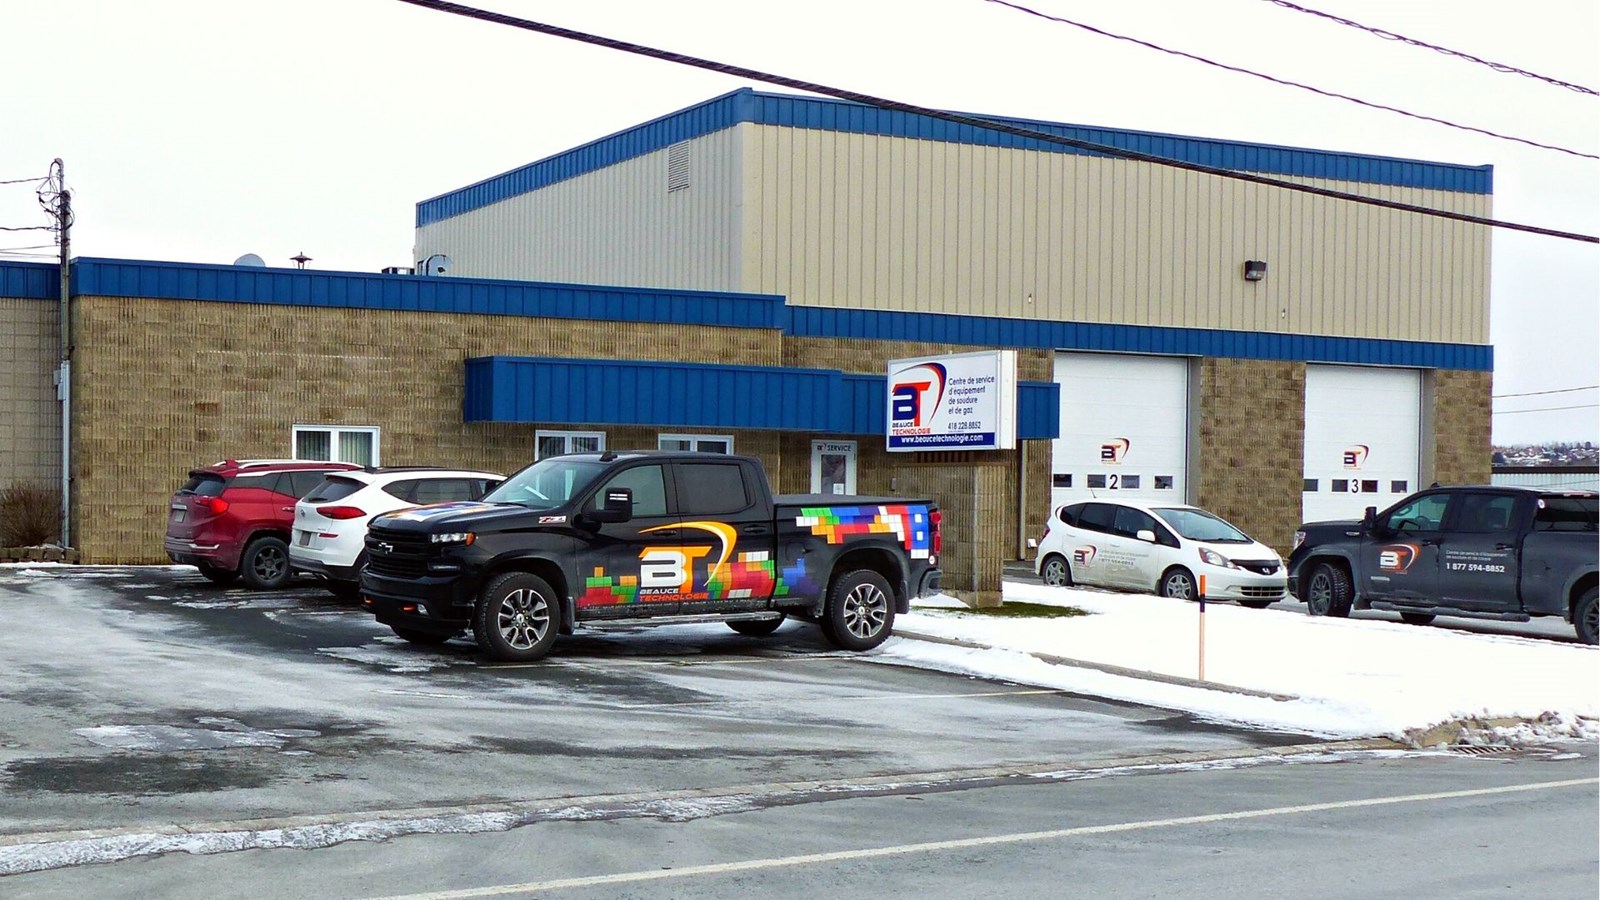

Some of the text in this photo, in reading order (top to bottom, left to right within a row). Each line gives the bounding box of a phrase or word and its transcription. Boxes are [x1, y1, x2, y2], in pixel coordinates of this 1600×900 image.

[948, 375, 995, 386] Centre de service
[948, 396, 978, 405] de soudure
[948, 406, 973, 416] et de gaz
[947, 422, 958, 430] 418
[901, 433, 984, 444] www.beaucetechnologie.com
[827, 444, 852, 452] SERVICE
[1109, 474, 1118, 490] 2
[1351, 479, 1359, 493] 3
[638, 546, 713, 594] BT
[1452, 563, 1467, 571] 877
[1468, 564, 1505, 572] 594-8852
[639, 592, 709, 602] TECHNOLOGIE
